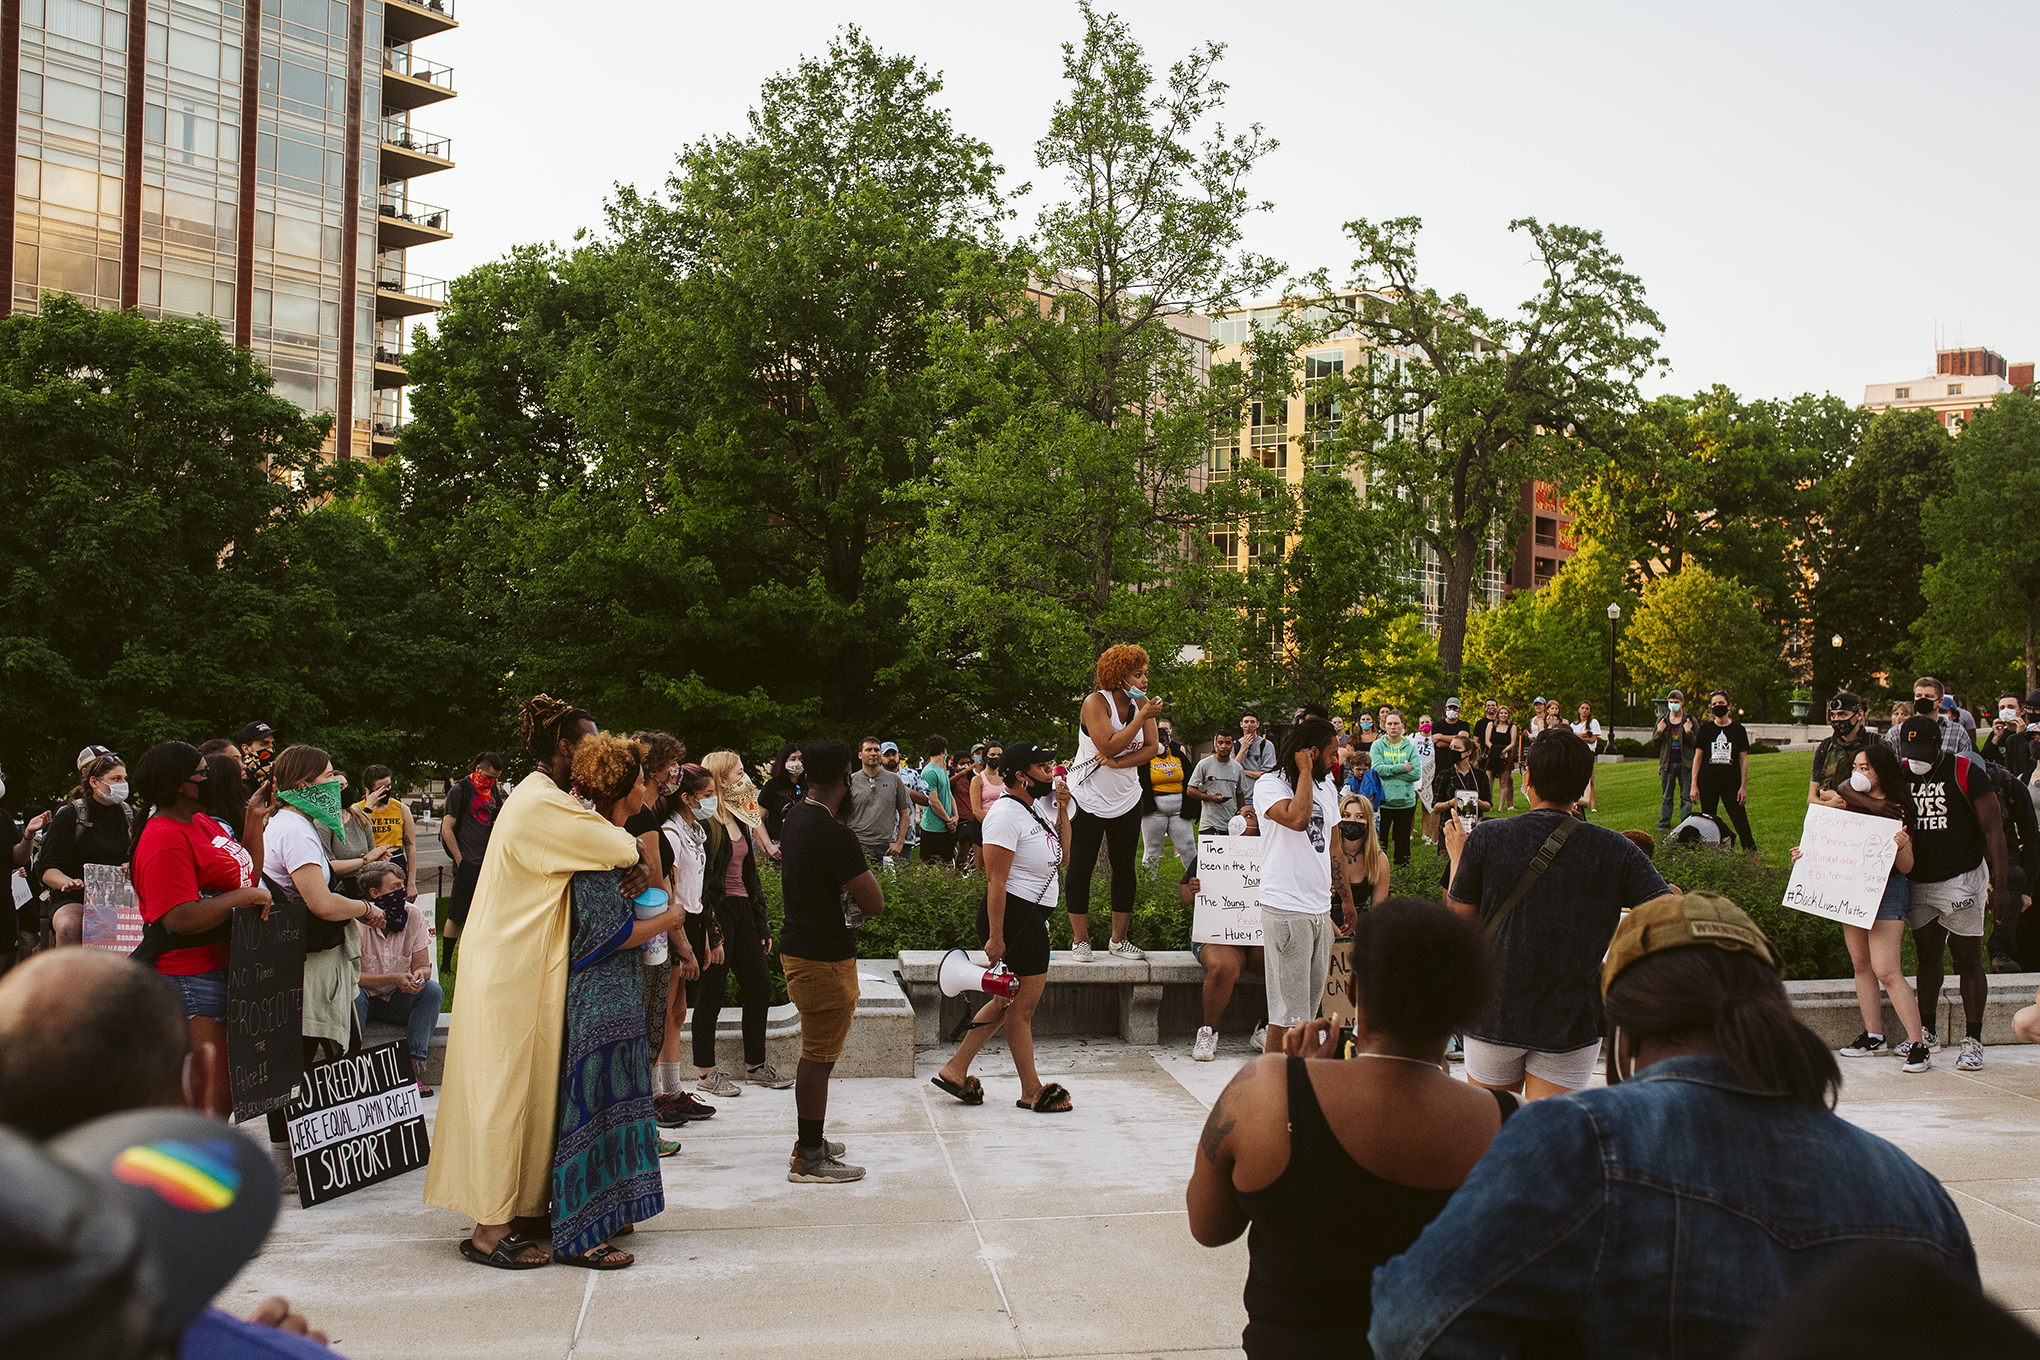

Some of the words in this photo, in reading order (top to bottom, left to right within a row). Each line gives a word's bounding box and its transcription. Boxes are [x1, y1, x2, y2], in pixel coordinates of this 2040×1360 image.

[1908, 731, 1917, 742] P
[1909, 782, 1946, 797] LACK
[1913, 797, 1948, 816] VES
[384, 817, 400, 825] THE
[1916, 816, 1948, 830] TTER
[373, 825, 391, 833] BEES
[1202, 840, 1224, 854] The
[1200, 860, 1221, 871] been
[1223, 863, 1230, 871] in
[1232, 860, 1246, 871] the
[1197, 895, 1217, 907] The
[1222, 896, 1245, 912] Young
[1951, 897, 1975, 909] NASA
[236, 914, 263, 950] NO
[267, 910, 301, 942] Justice
[1224, 926, 1252, 941] Huey
[232, 967, 249, 989] NO
[254, 963, 275, 983] Peace
[230, 987, 304, 1037] PROSECUTE
[314, 1052, 380, 1107] FREEDOM
[375, 1041, 409, 1088] TIL'
[322, 1107, 361, 1141] EQUAL,
[358, 1098, 385, 1129] DAMN
[386, 1089, 418, 1118] RIGHT
[305, 1156, 315, 1201] I
[320, 1128, 392, 1191] SUPPORT
[399, 1118, 421, 1166] IT
